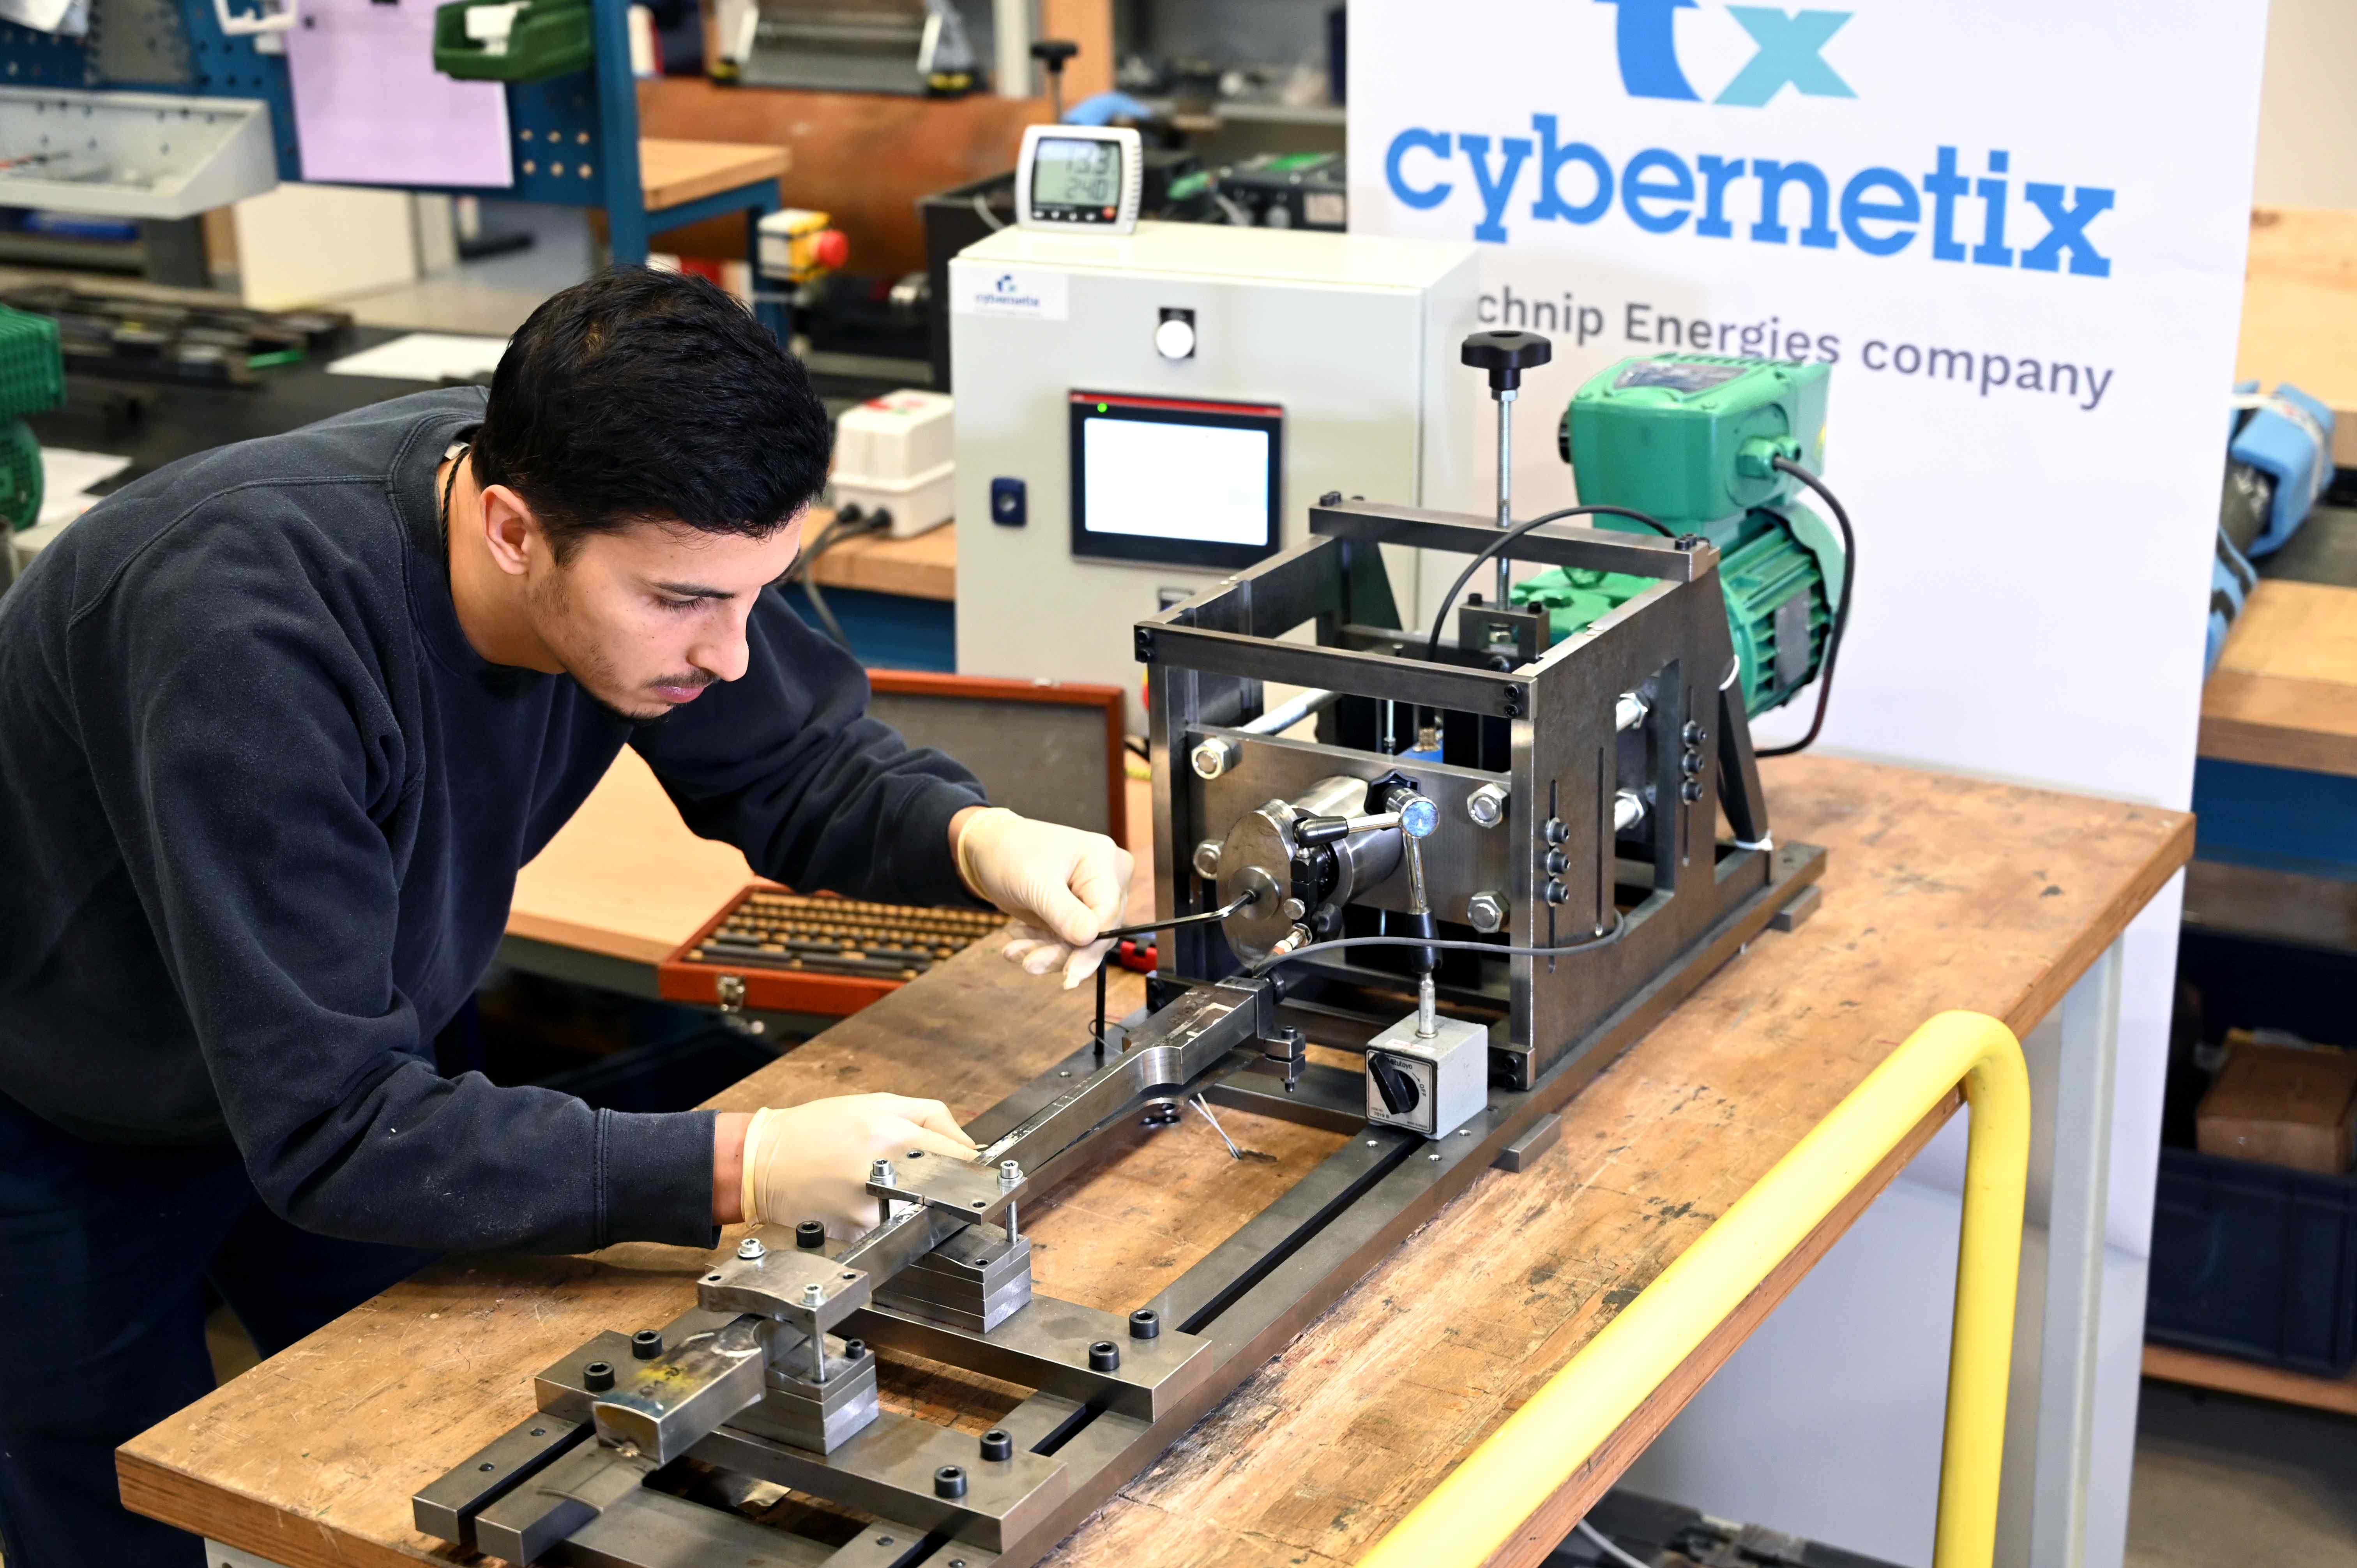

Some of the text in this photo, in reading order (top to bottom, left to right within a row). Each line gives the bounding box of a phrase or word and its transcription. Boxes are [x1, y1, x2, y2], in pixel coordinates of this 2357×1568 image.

[1385, 113, 2116, 278] cybernetix
[1626, 304, 1840, 365] Energies
[1863, 341, 2112, 410] company
[1387, 1058, 1412, 1069] Mitutoyo
